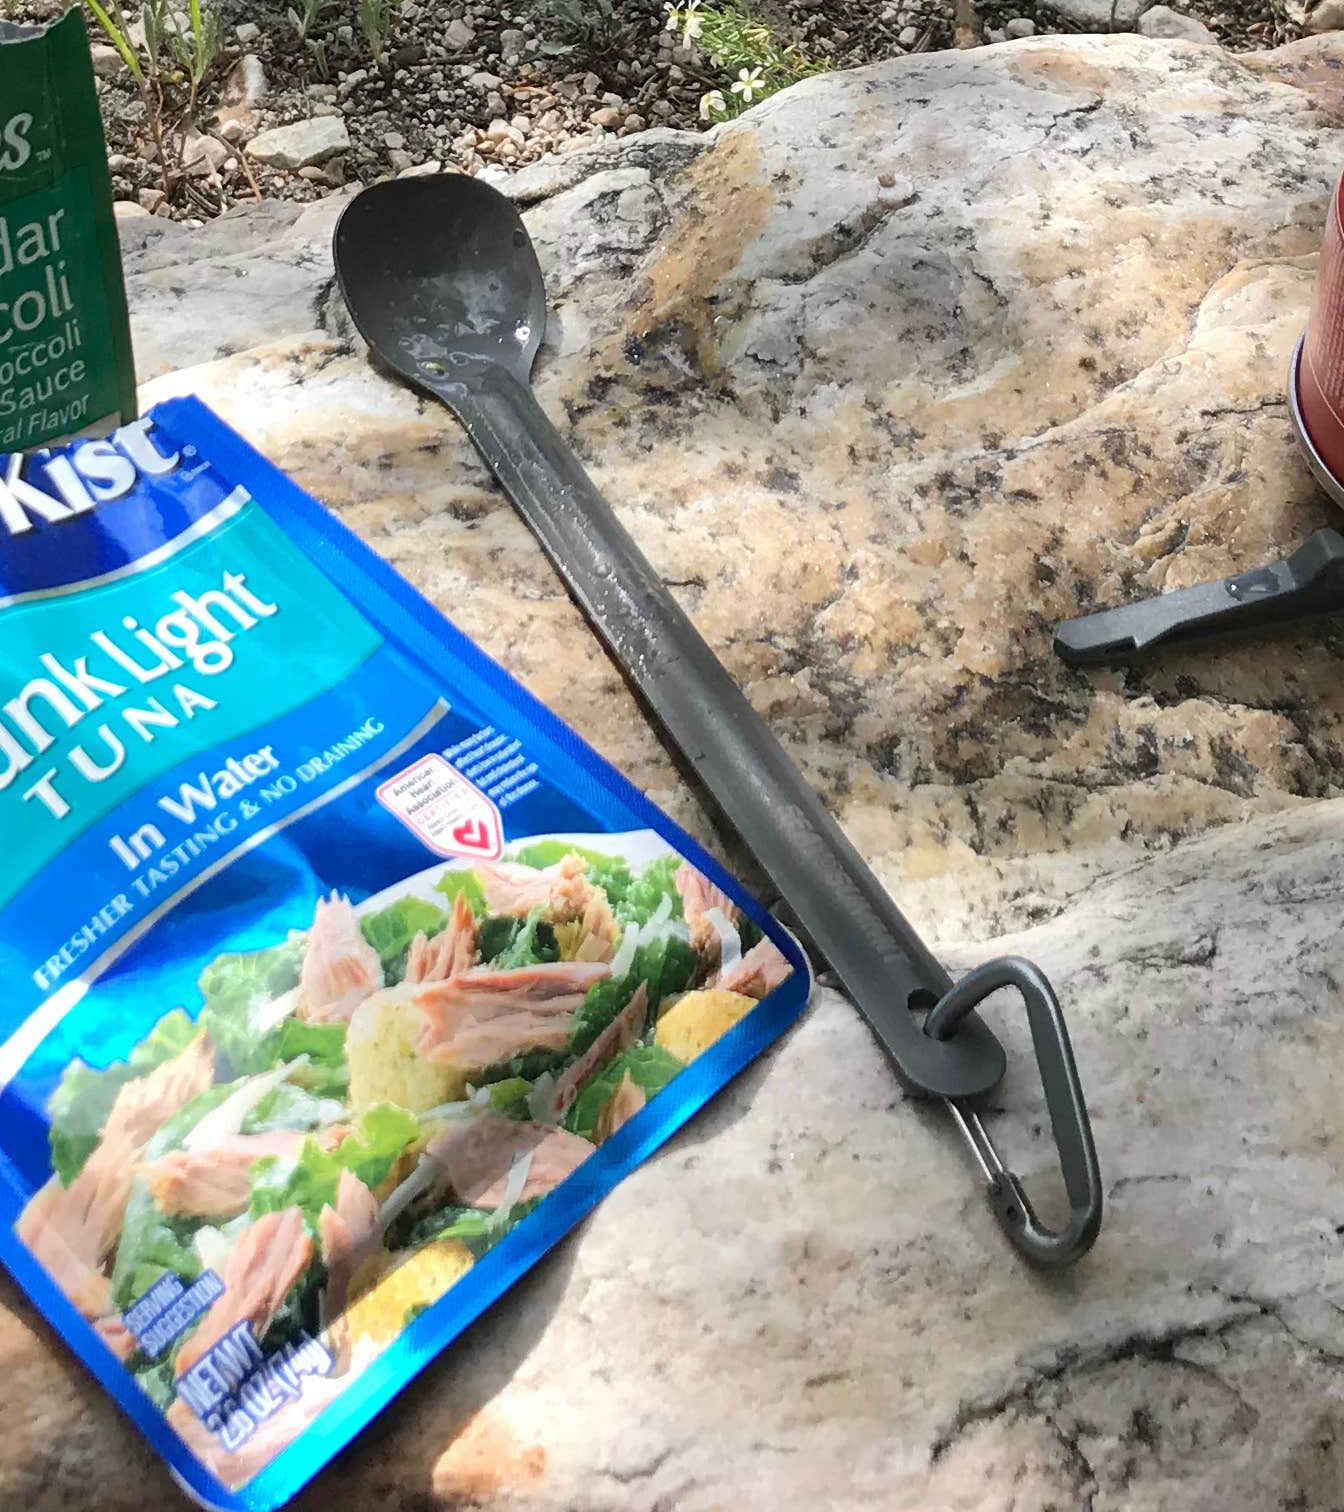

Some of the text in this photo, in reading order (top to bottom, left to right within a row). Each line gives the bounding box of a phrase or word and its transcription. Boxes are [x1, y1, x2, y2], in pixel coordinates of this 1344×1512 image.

[0, 360, 86, 418] Sauce
[27, 393, 89, 436] Flavor
[91, 570, 279, 676] Light
[22, 686, 219, 823] TUNA
[410, 780, 433, 798] Hear
[110, 740, 281, 870] In Water
[33, 890, 134, 992] FRESHER
[131, 811, 237, 901] TASTING
[241, 796, 263, 820] &
[260, 773, 300, 810] NO
[295, 716, 387, 786] DRAINING
[139, 1270, 224, 1358] SUGGESTION
[177, 1320, 263, 1416] NET WT
